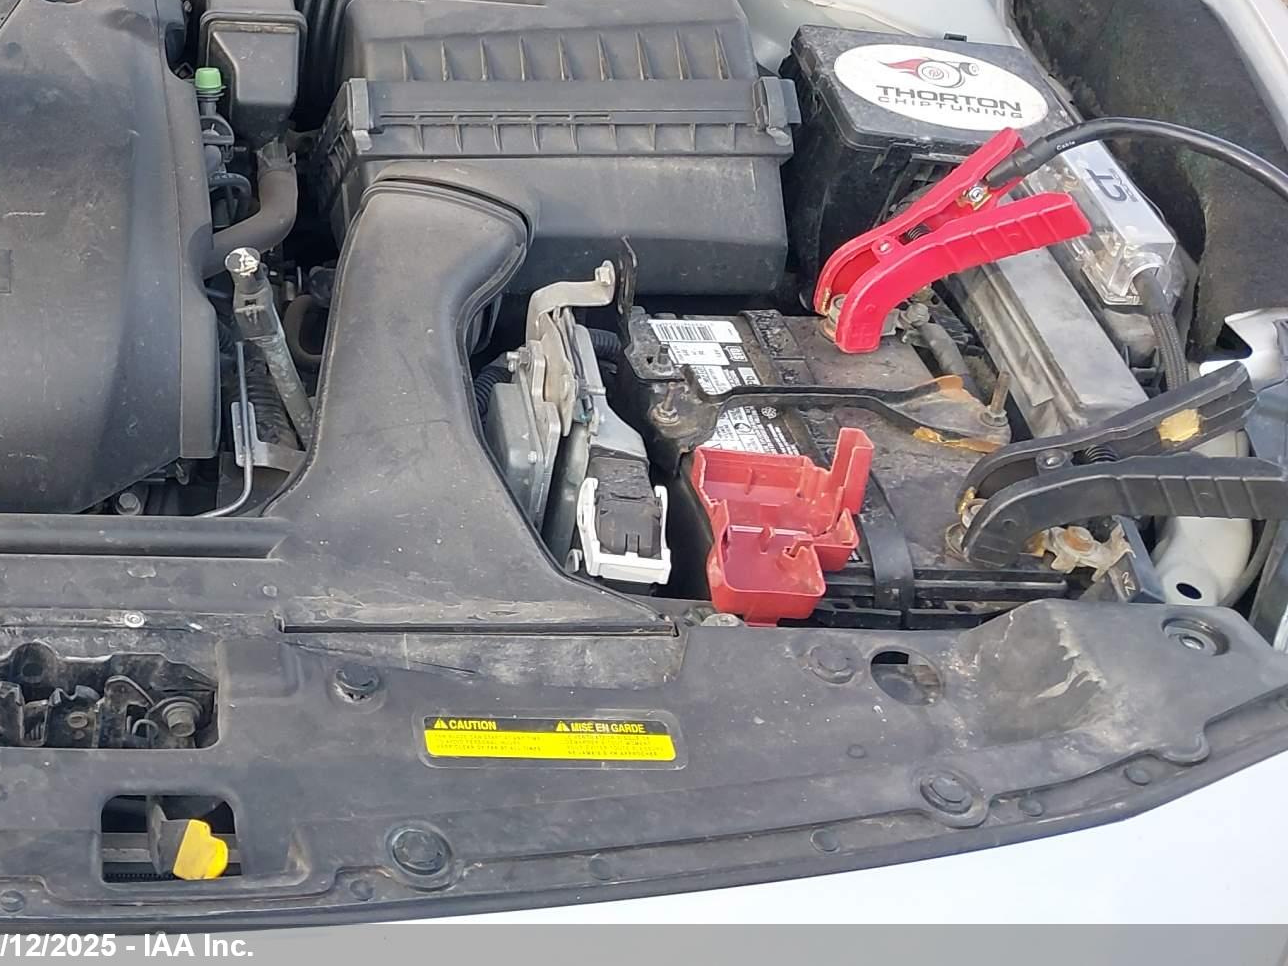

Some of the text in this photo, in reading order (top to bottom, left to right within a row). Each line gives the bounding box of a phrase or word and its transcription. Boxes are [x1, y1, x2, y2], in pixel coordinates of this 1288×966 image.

[876, 85, 1022, 112] THORTON
[877, 96, 1024, 119] CHIPTUNING
[1056, 140, 1076, 151] Cable
[448, 719, 497, 731] CAUTION
[570, 722, 646, 733] MISE EN GARDE
